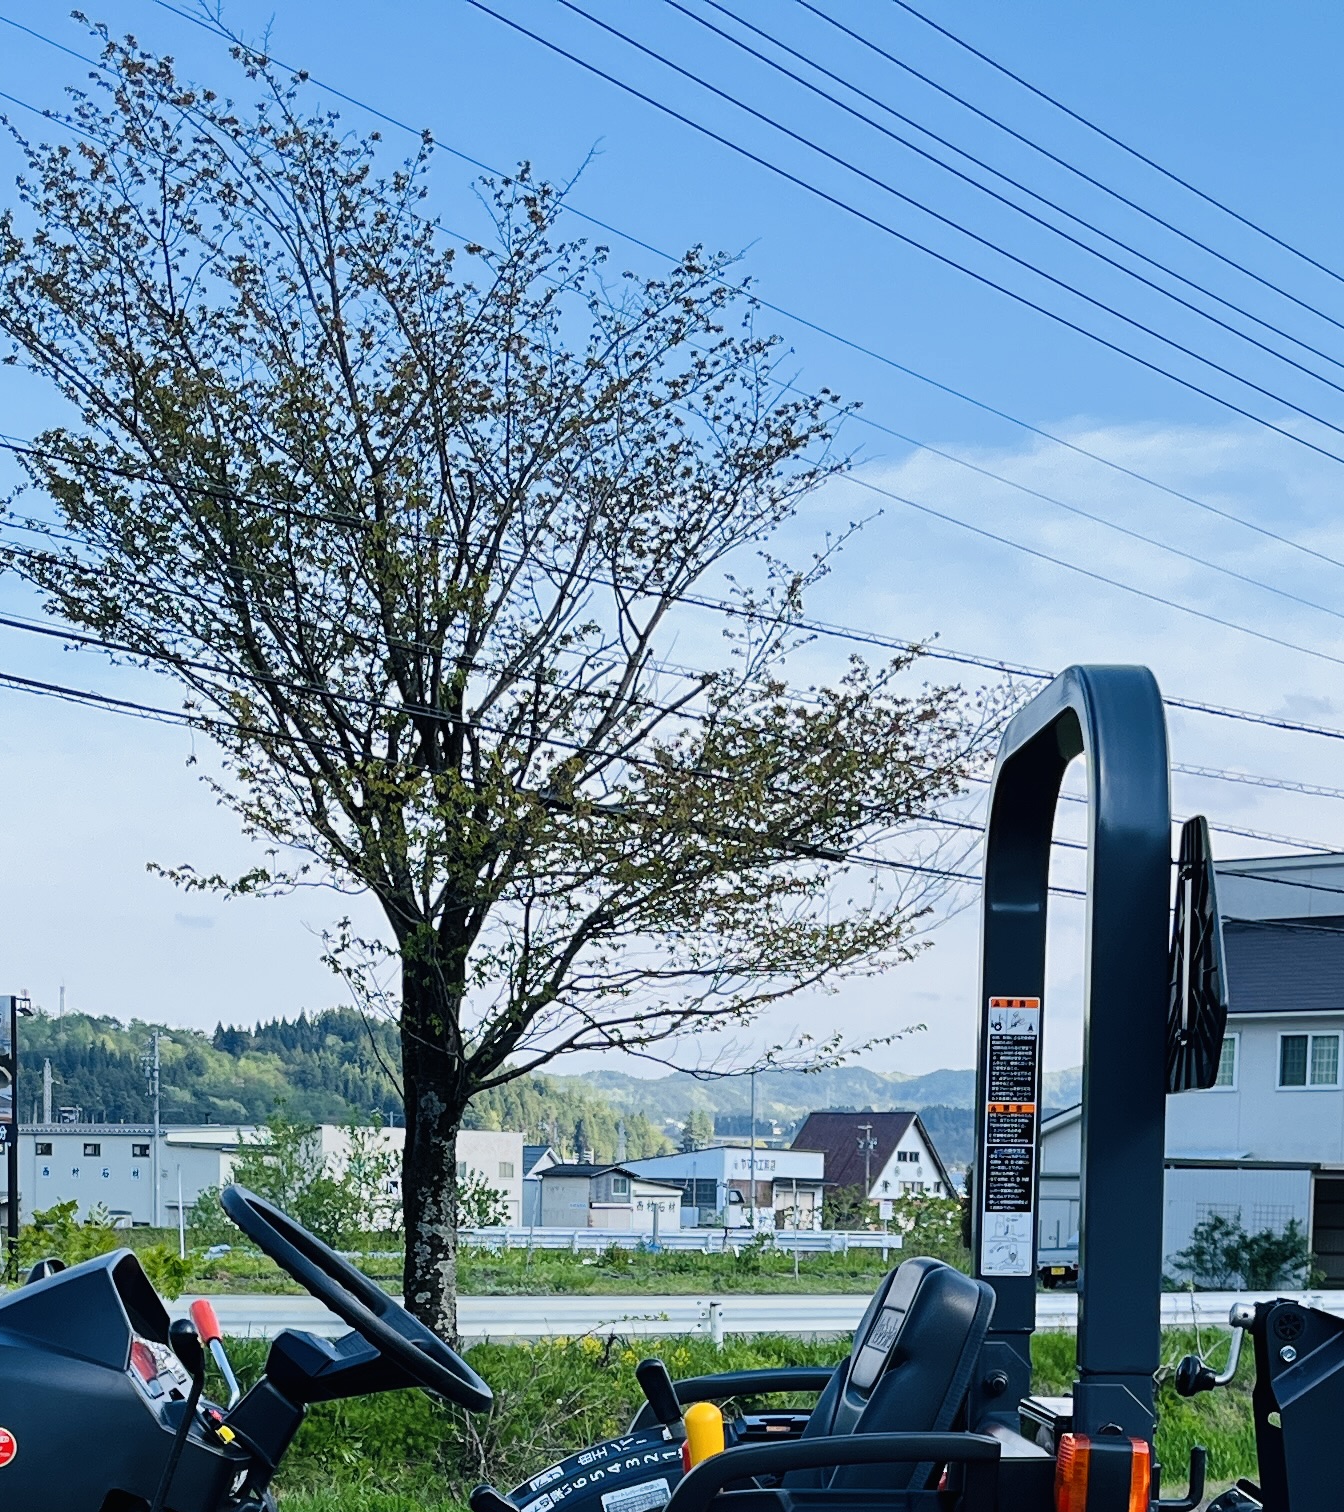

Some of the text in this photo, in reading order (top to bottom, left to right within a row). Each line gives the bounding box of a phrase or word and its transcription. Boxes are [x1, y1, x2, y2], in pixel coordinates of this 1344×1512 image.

[573, 1478, 587, 1489] 6
[589, 1470, 605, 1482] 5
[607, 1463, 622, 1474] 4
[625, 1458, 641, 1469] 3
[643, 1452, 659, 1464] 2
[662, 1451, 677, 1460] 1
